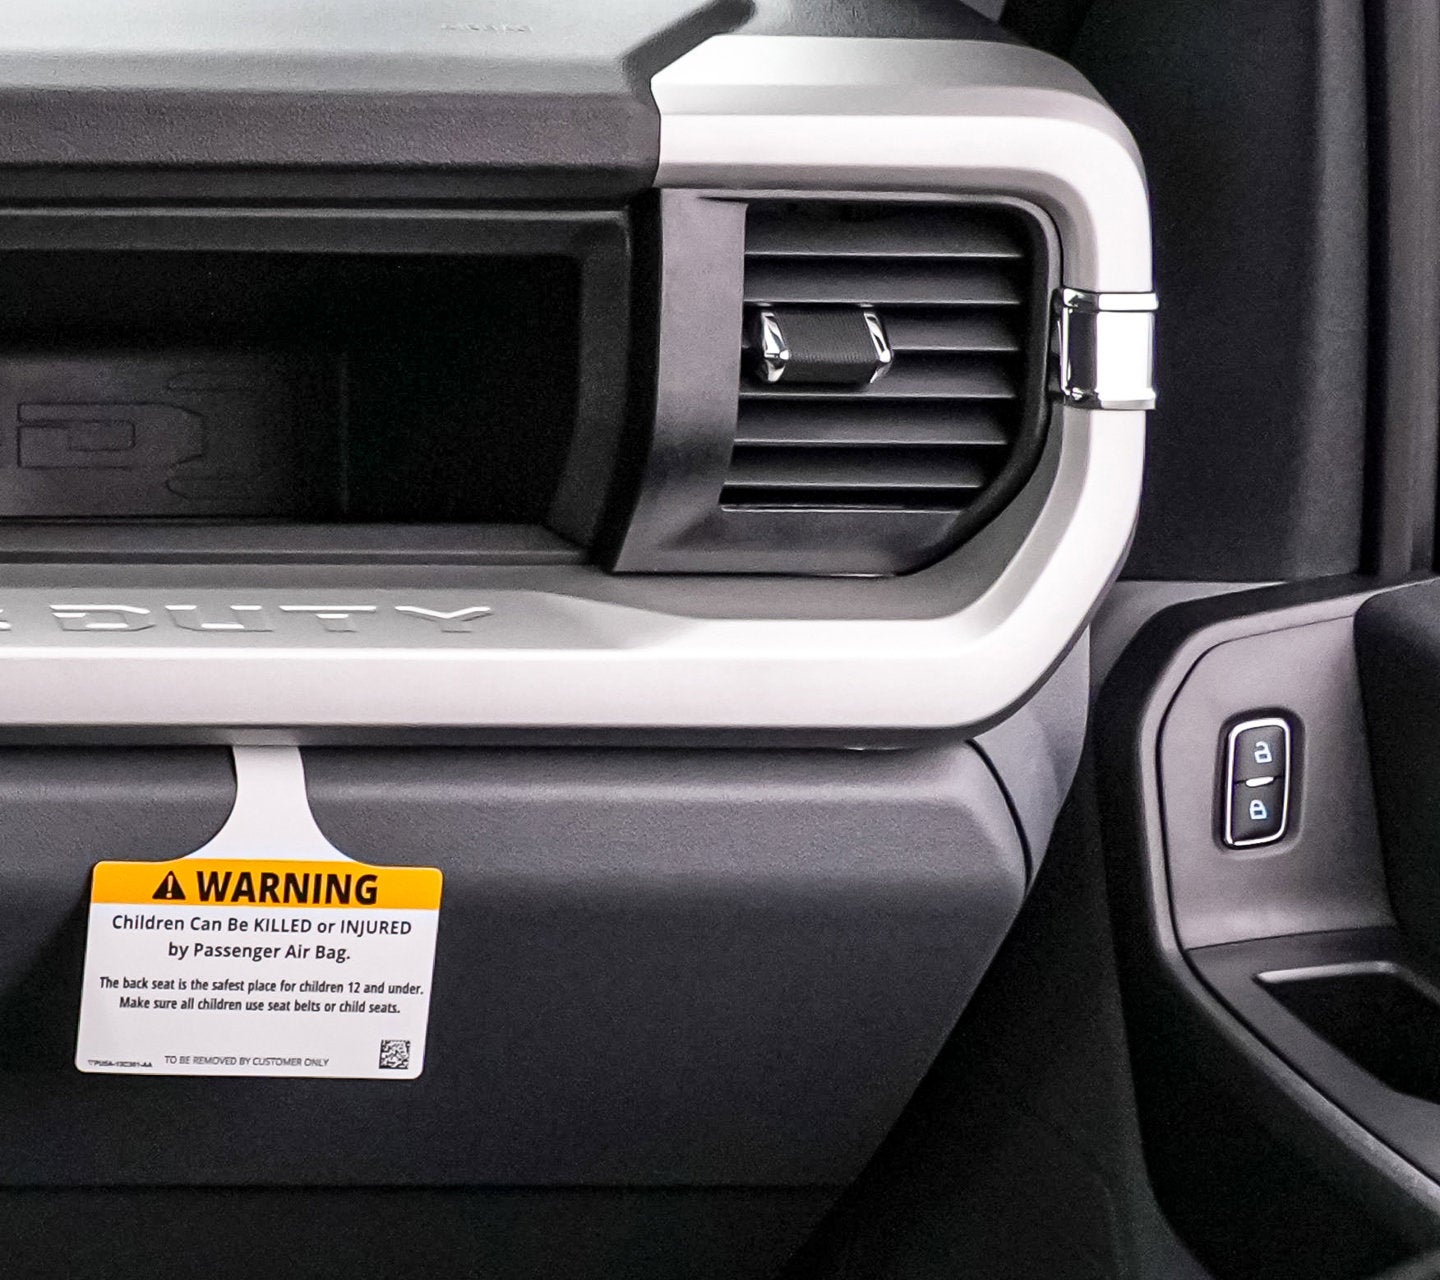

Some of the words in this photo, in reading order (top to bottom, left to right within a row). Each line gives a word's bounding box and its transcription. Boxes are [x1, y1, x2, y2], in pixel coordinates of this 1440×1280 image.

[49, 600, 495, 634] DUTY
[196, 871, 378, 906] WARNING
[112, 915, 184, 931] Children
[190, 917, 222, 932] Can
[227, 918, 249, 932] Be
[254, 918, 311, 933] KILLED
[317, 922, 336, 934] or
[340, 920, 412, 936] INJURED
[169, 941, 188, 960] by
[194, 943, 280, 962] Passenger
[285, 944, 310, 960] Air
[315, 944, 351, 963] Bag.
[99, 976, 119, 988] The
[123, 976, 148, 990] back
[152, 978, 175, 990] seat
[178, 978, 187, 990] is
[190, 978, 209, 990] the
[212, 978, 244, 992] safest
[248, 979, 276, 994] place
[280, 979, 296, 992] for
[299, 980, 344, 993] children
[348, 981, 360, 993] 12
[363, 981, 385, 994] and
[388, 982, 424, 995] under.
[119, 997, 150, 1010] Make
[154, 999, 178, 1010] sure
[181, 997, 195, 1011] all
[198, 998, 242, 1011] children
[245, 1001, 264, 1012] use
[267, 1000, 291, 1012] seat
[294, 999, 320, 1012] belts
[325, 1002, 336, 1013] or
[339, 1000, 365, 1013] child
[369, 1001, 401, 1014] seats.
[165, 1055, 178, 1064] TO
[179, 1056, 191, 1064] BE
[192, 1056, 237, 1065] REMOVED
[240, 1057, 251, 1066] BY
[252, 1058, 302, 1067] CUSTOMER
[304, 1058, 329, 1067] ONLY
